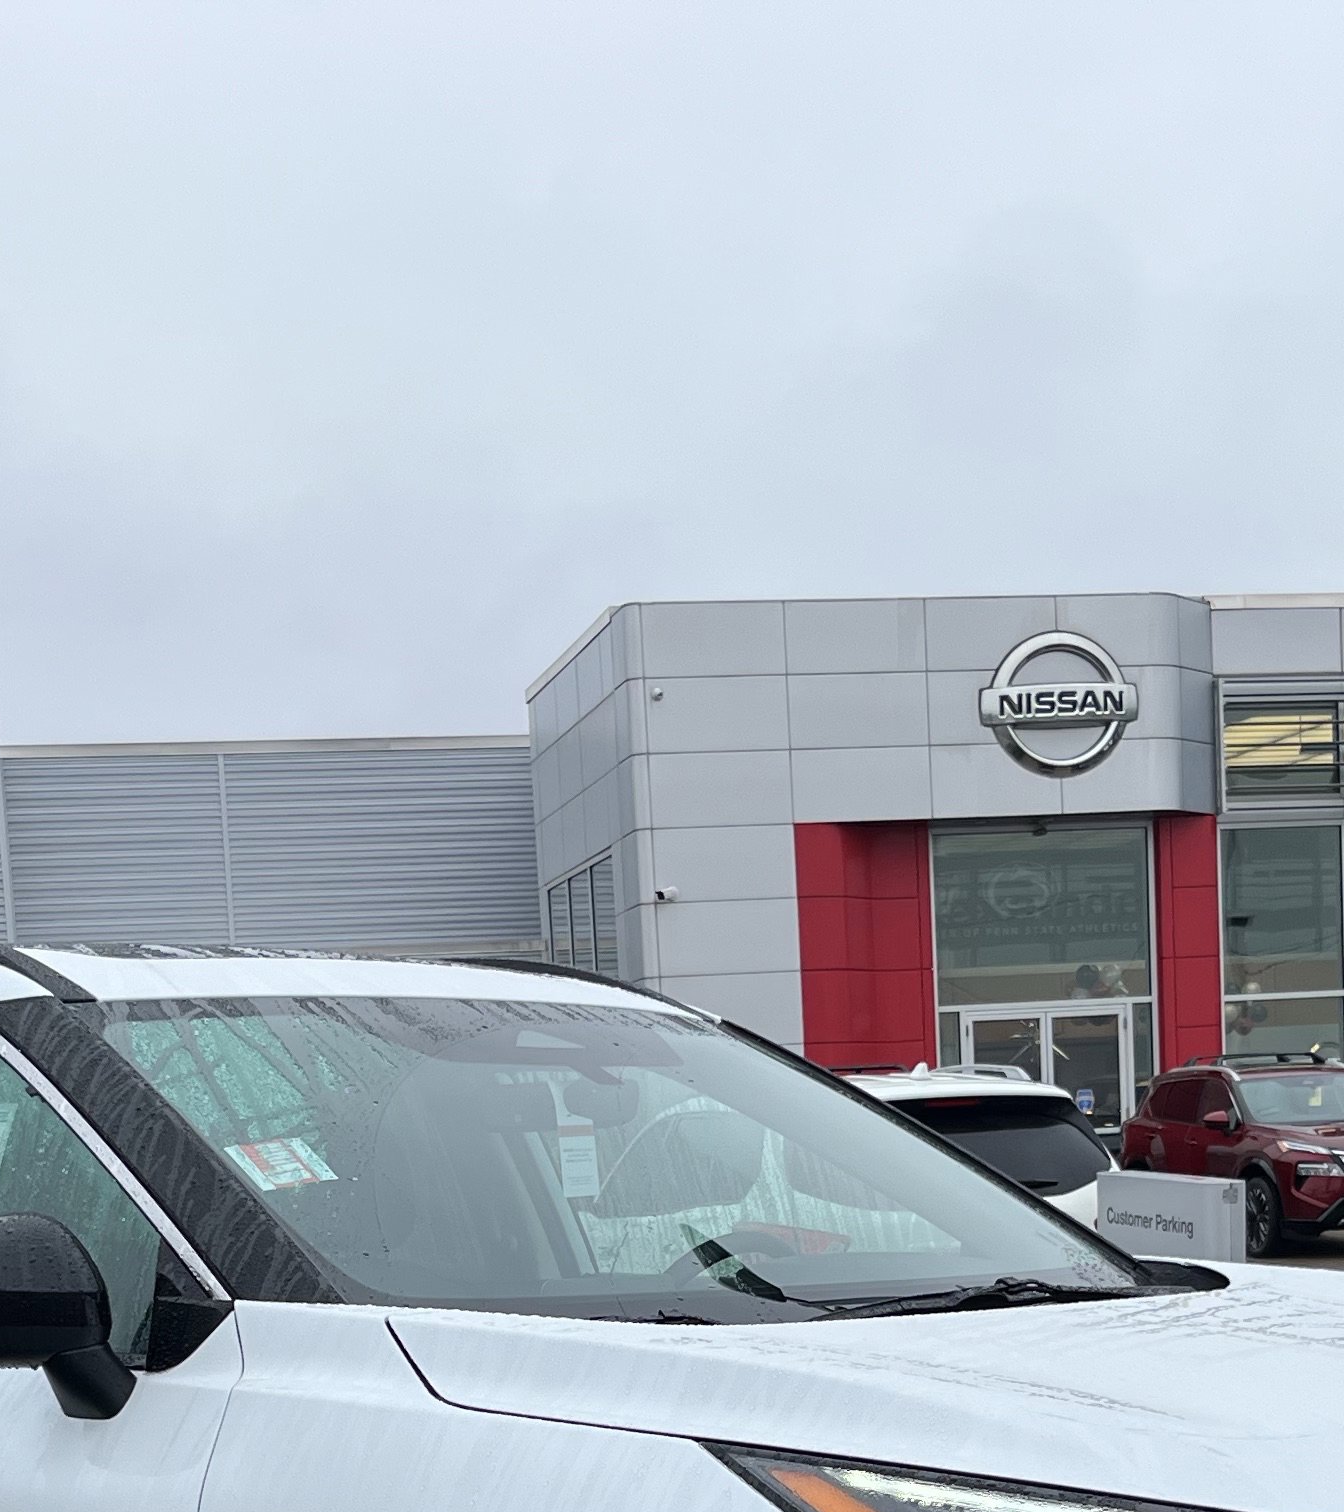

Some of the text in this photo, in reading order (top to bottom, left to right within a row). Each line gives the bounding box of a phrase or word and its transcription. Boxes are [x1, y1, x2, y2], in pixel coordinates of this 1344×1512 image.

[998, 690, 1126, 718] NISSAN
[1106, 1207, 1194, 1240] Customer Parking
